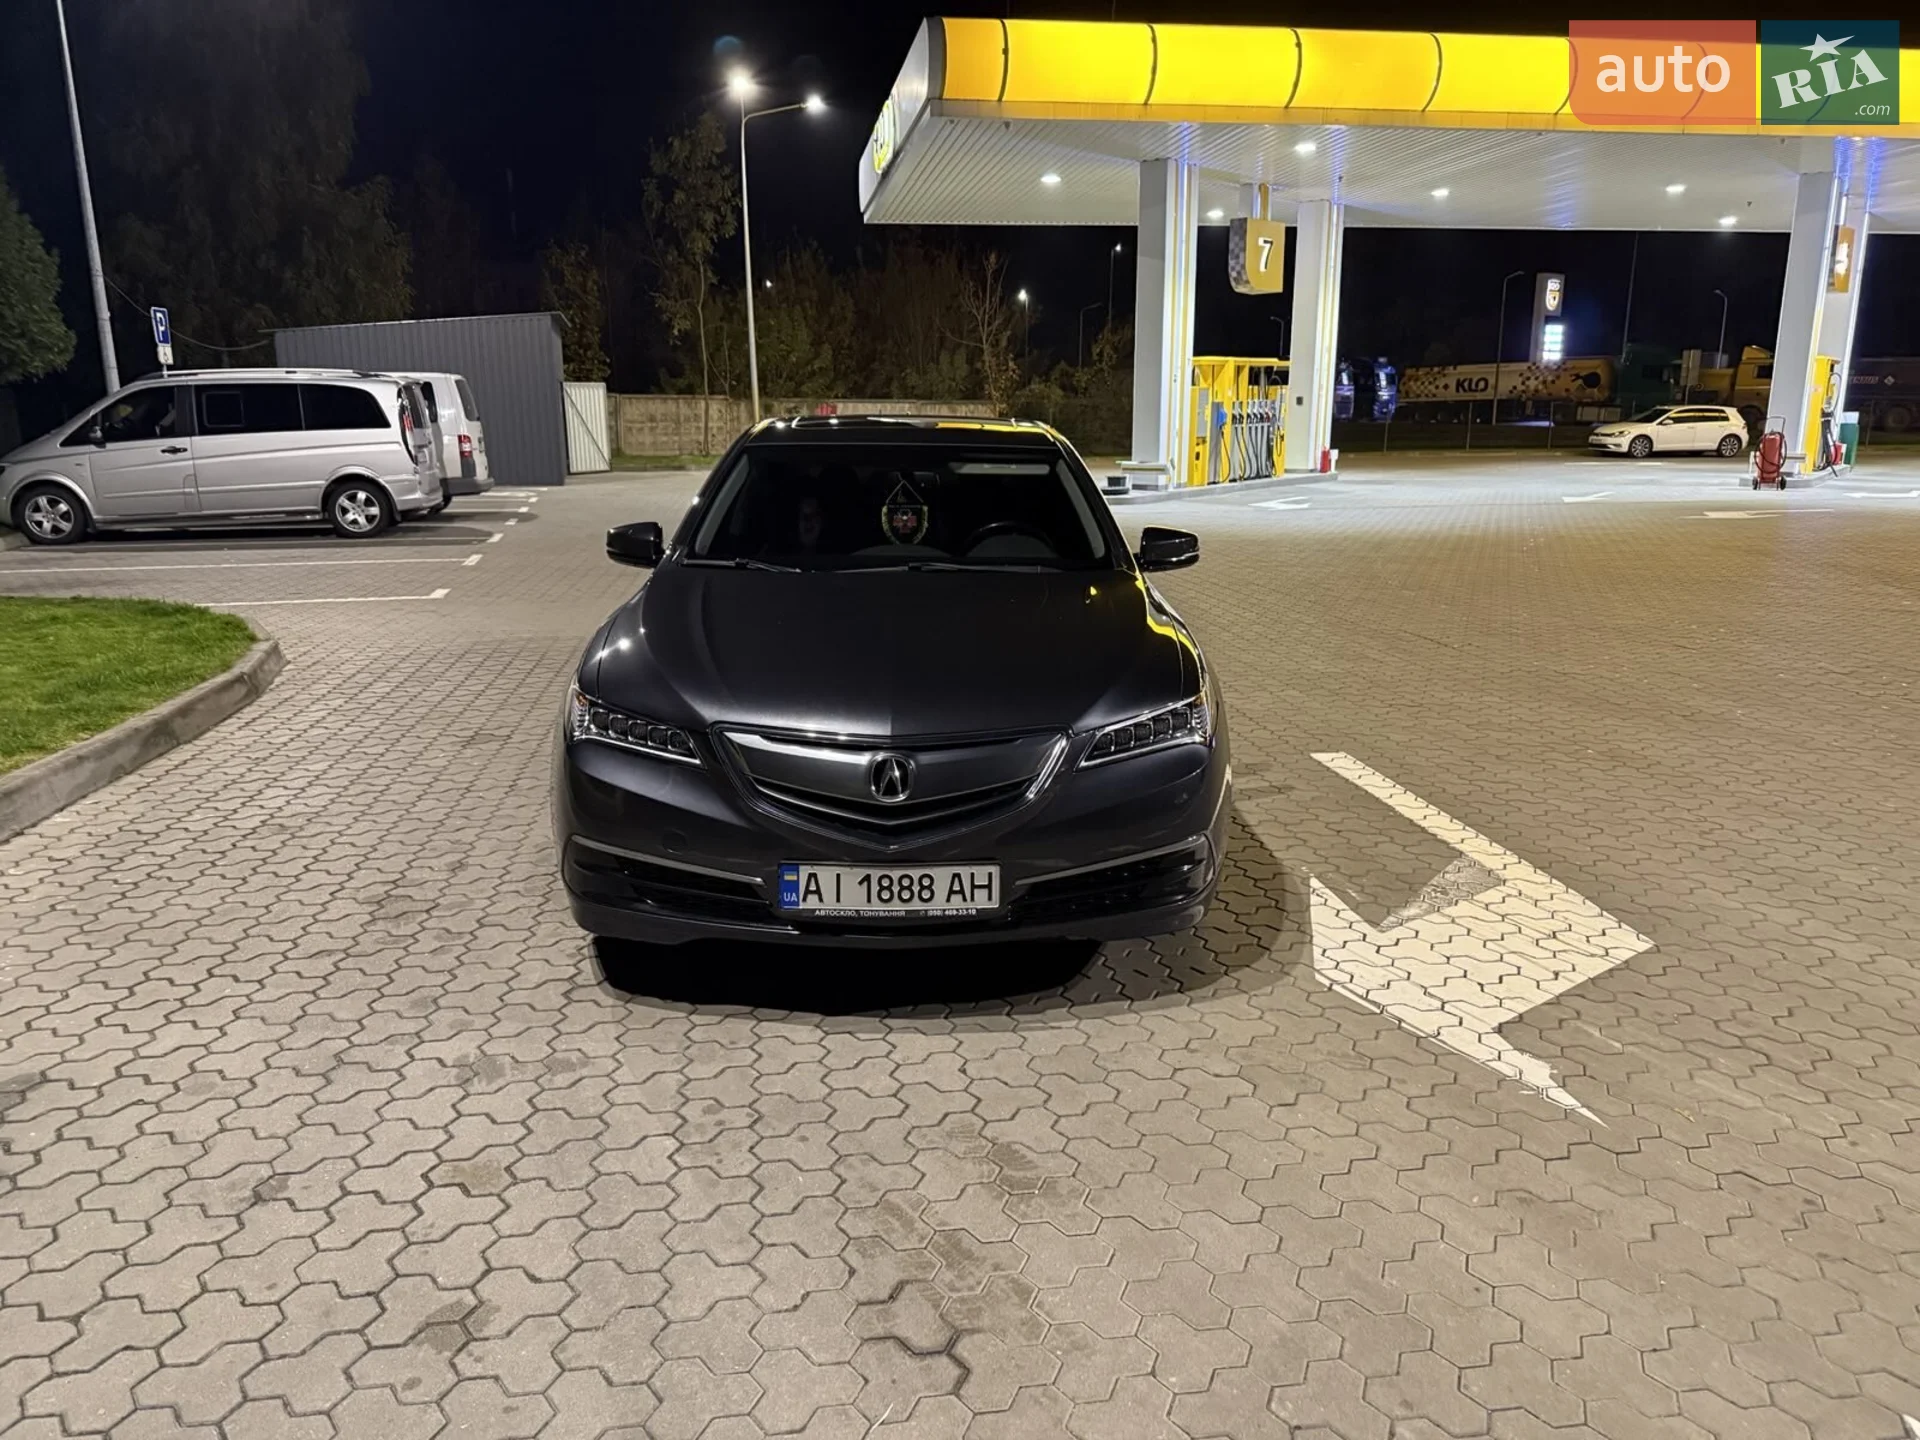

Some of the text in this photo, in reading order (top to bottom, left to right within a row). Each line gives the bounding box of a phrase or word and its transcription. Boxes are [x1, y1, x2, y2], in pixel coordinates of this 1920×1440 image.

[1258, 237, 1273, 272] 7
[156, 312, 166, 341] P
[1455, 377, 1489, 393] KLO
[783, 892, 798, 902] UA
[801, 871, 993, 904] AI 1888 AH
